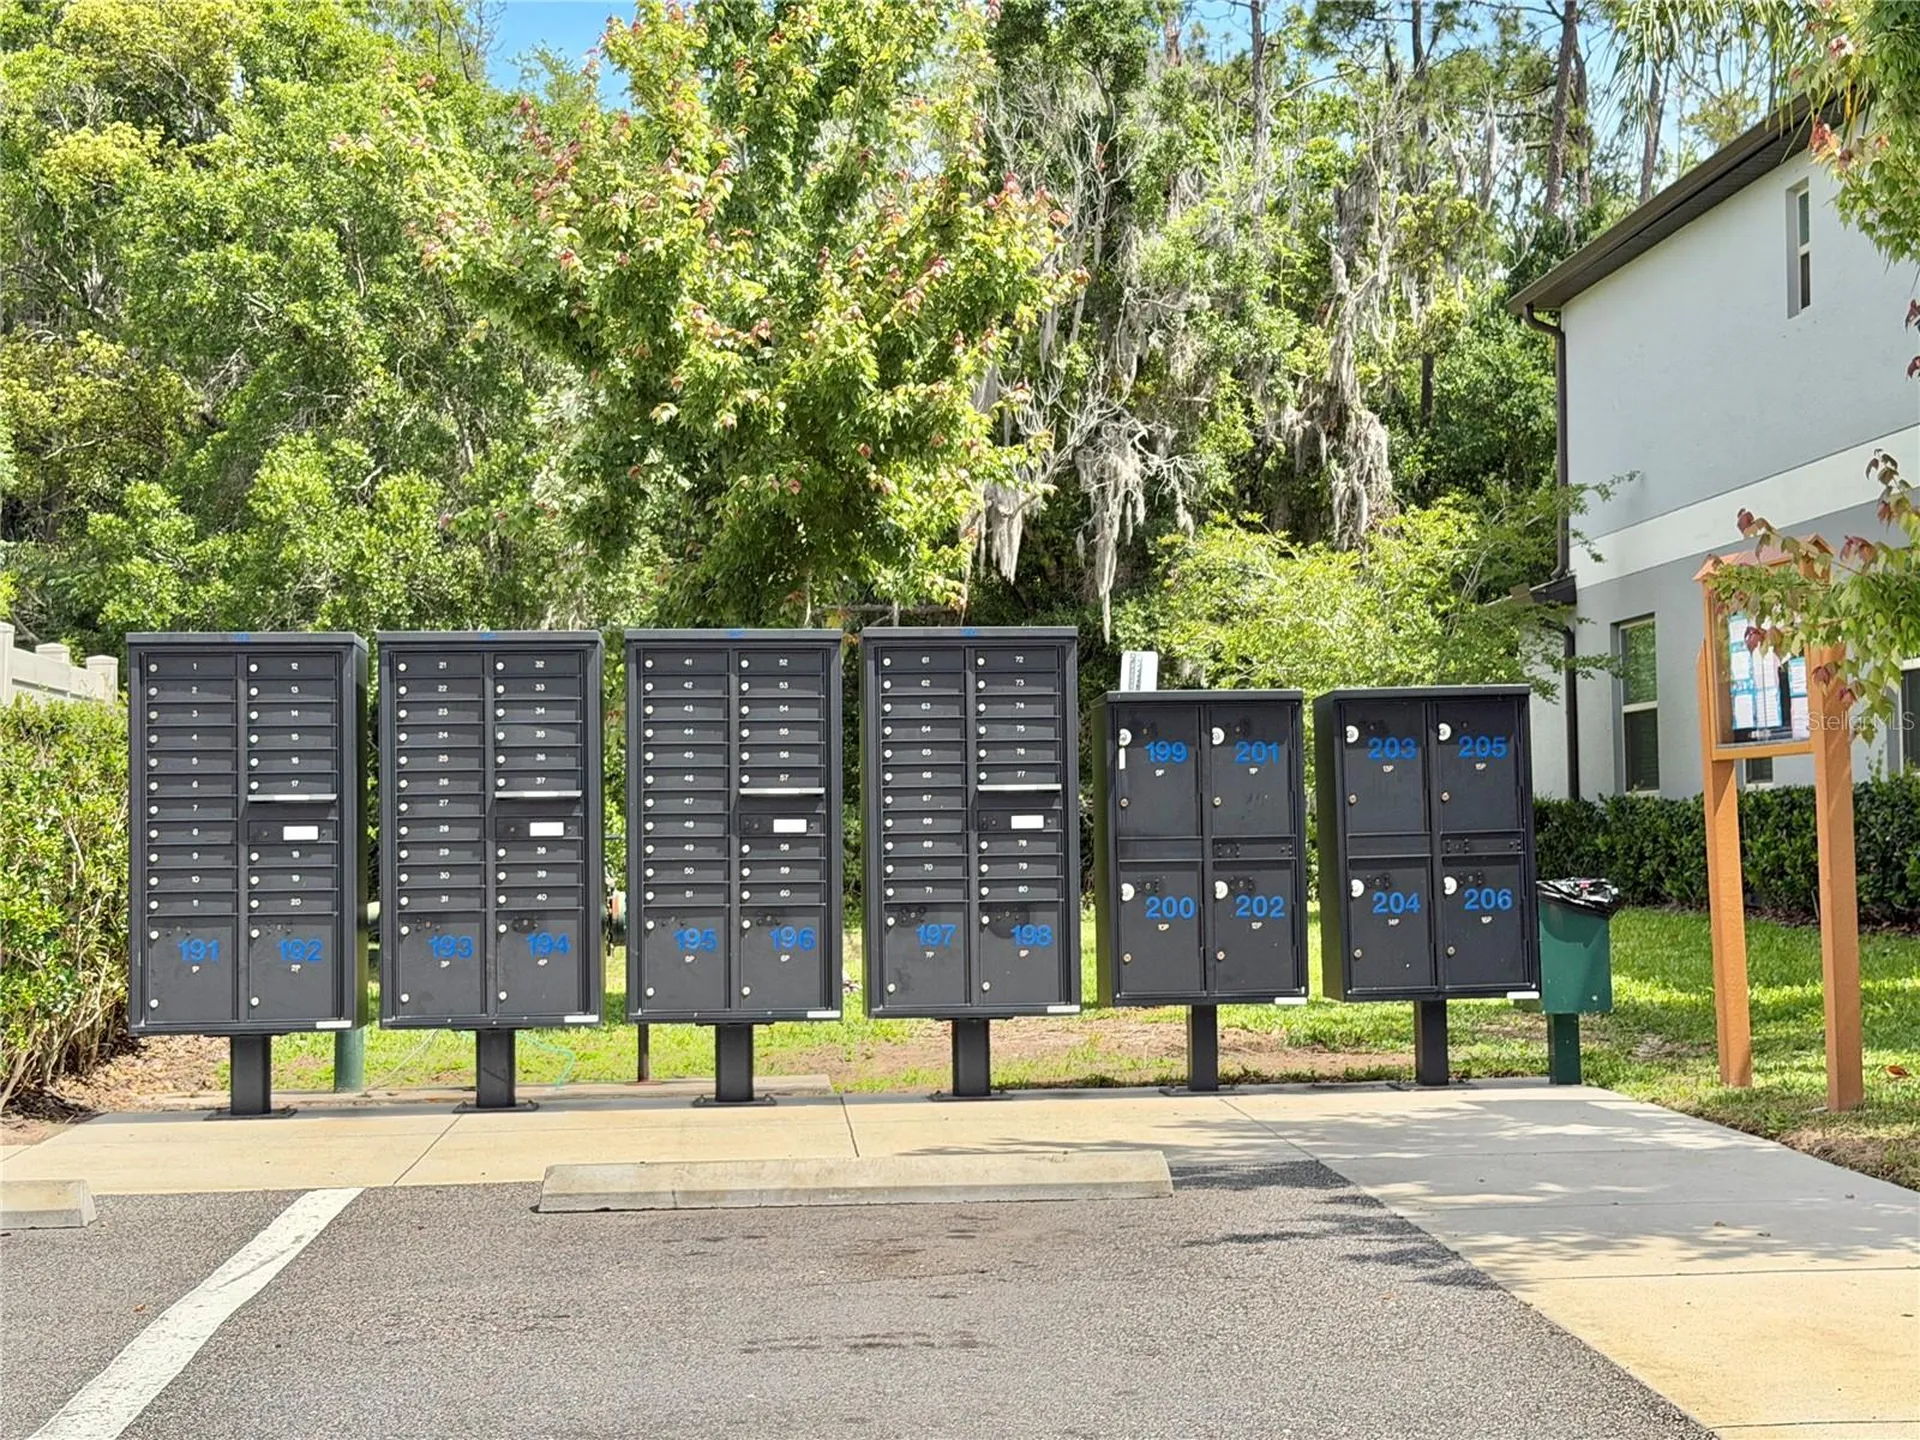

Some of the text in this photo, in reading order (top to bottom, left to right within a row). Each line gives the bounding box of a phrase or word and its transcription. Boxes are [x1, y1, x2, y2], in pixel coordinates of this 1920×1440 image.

[1145, 741, 1188, 764] 199
[1235, 742, 1279, 765] 201
[1369, 738, 1417, 761] 203
[1459, 736, 1507, 758] 205
[1147, 896, 1196, 920] 200
[1236, 895, 1285, 919] 202
[1373, 892, 1420, 914] 204
[1464, 888, 1512, 910] 206
[526, 933, 570, 956] 194
[673, 929, 717, 952] 195
[769, 929, 816, 950] 196
[915, 924, 956, 947] 197
[1010, 925, 1052, 947] 198
[178, 940, 219, 961] 191
[278, 940, 322, 961] 192
[428, 936, 473, 959] 193
